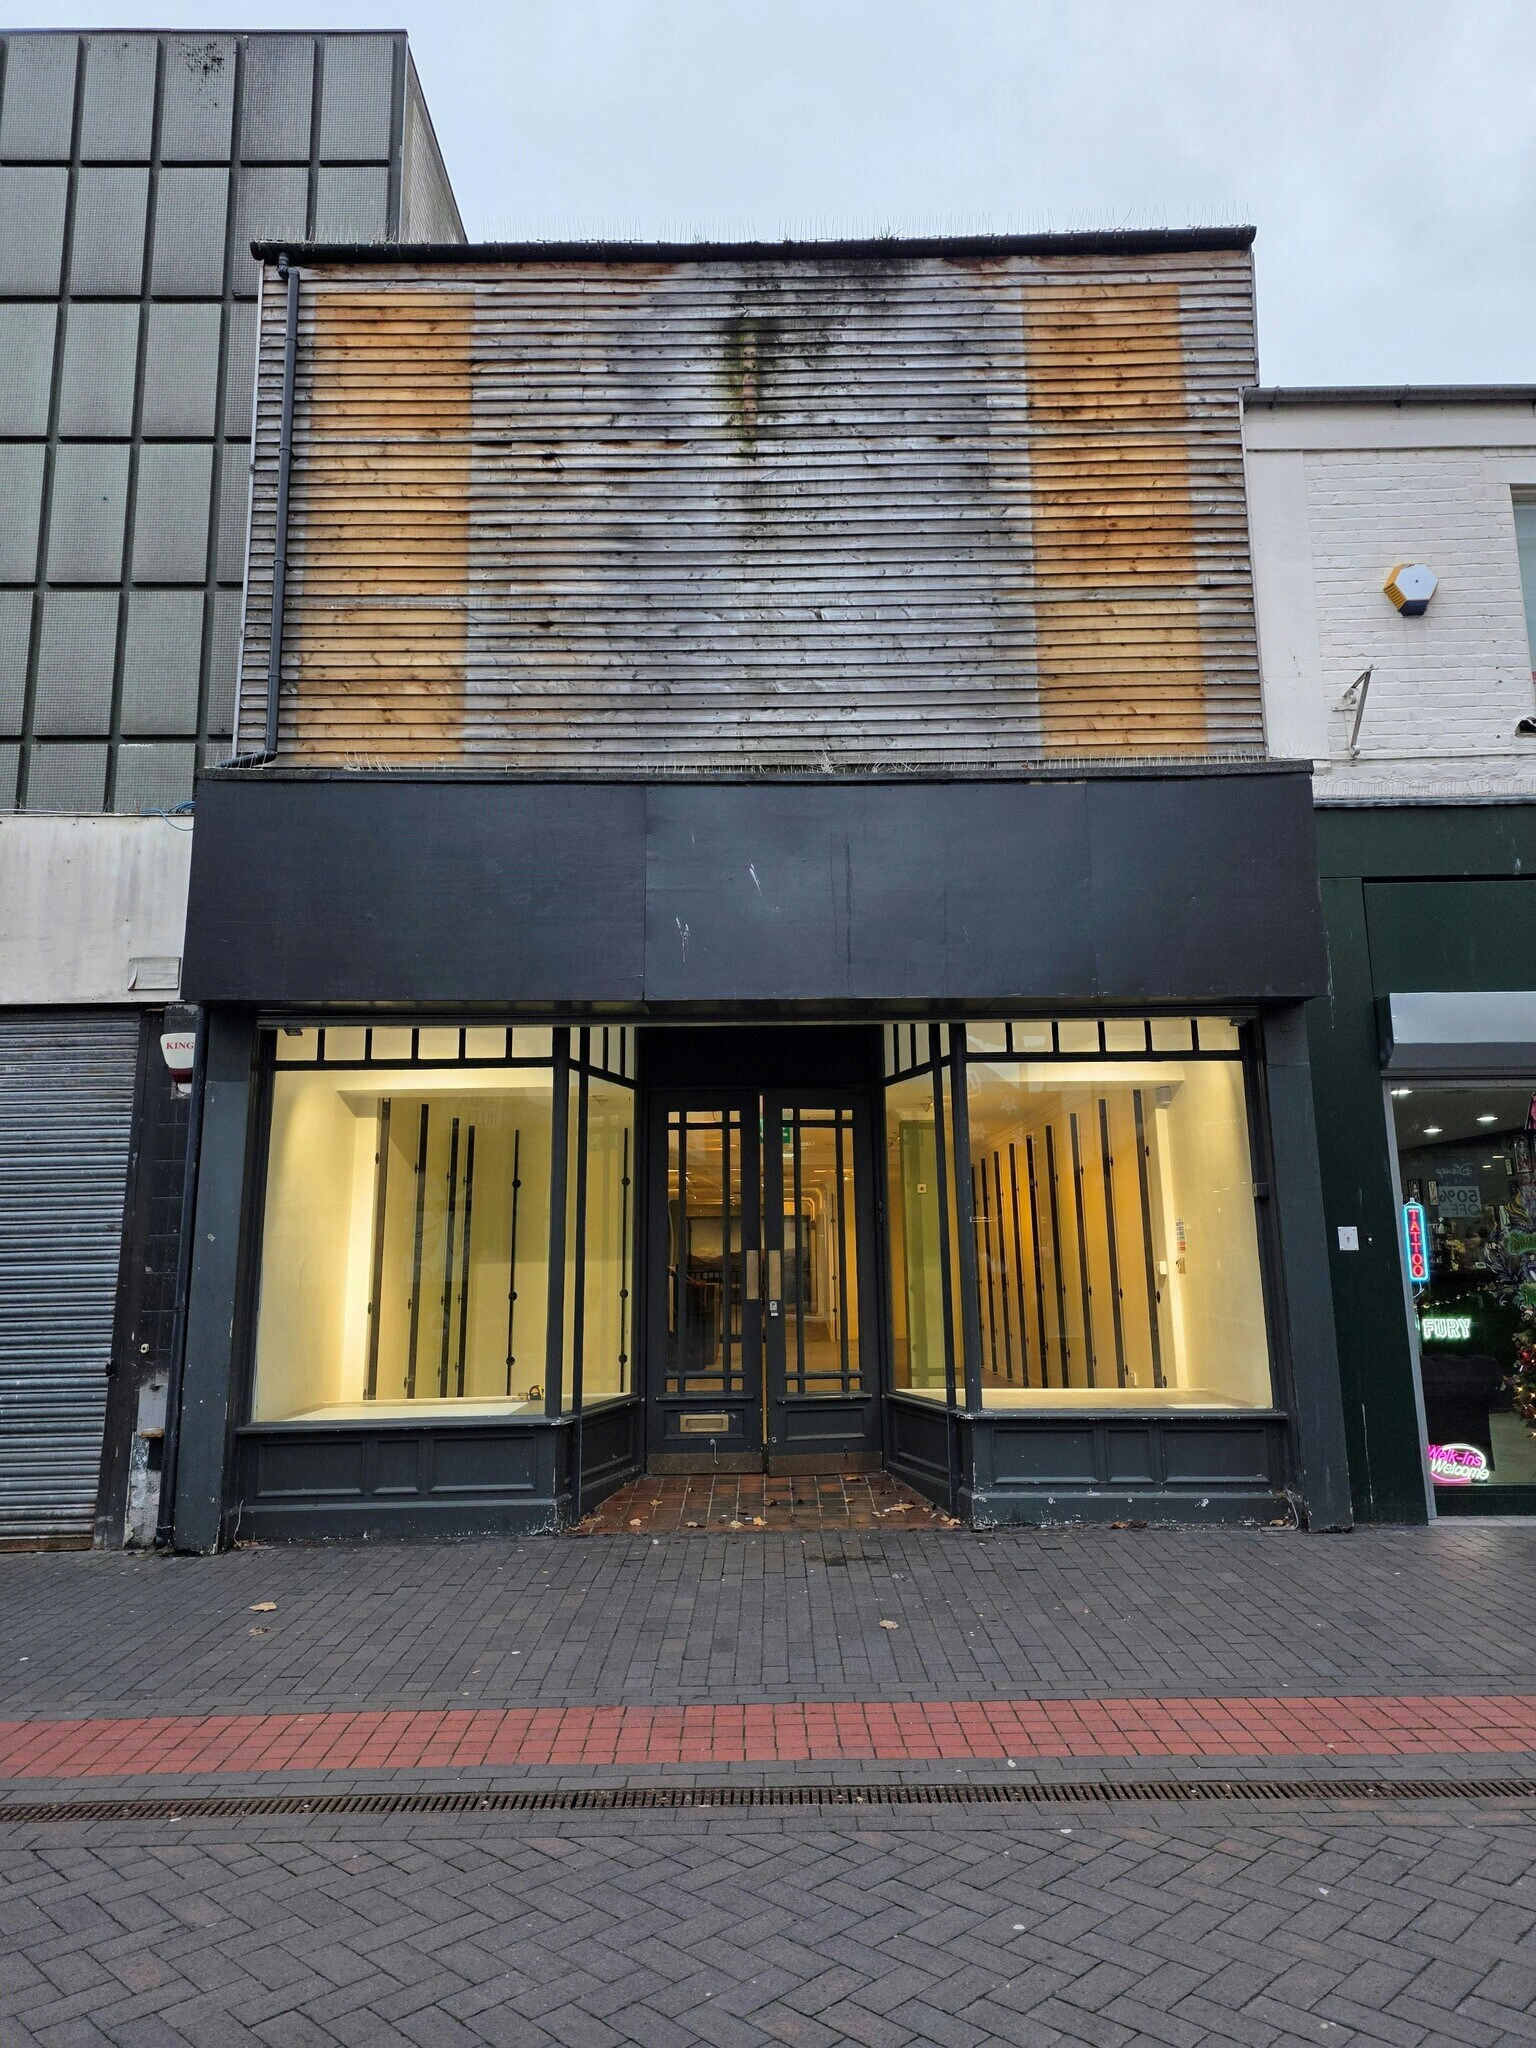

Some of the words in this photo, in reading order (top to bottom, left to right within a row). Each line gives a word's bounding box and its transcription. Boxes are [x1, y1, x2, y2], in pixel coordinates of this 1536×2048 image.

[166, 1042, 194, 1050] KING
[1408, 1209, 1425, 1277] TATTOO
[1422, 1318, 1472, 1340] FURY
[1428, 1445, 1482, 1466] Walk-Ins
[1431, 1458, 1490, 1481] Welcome
